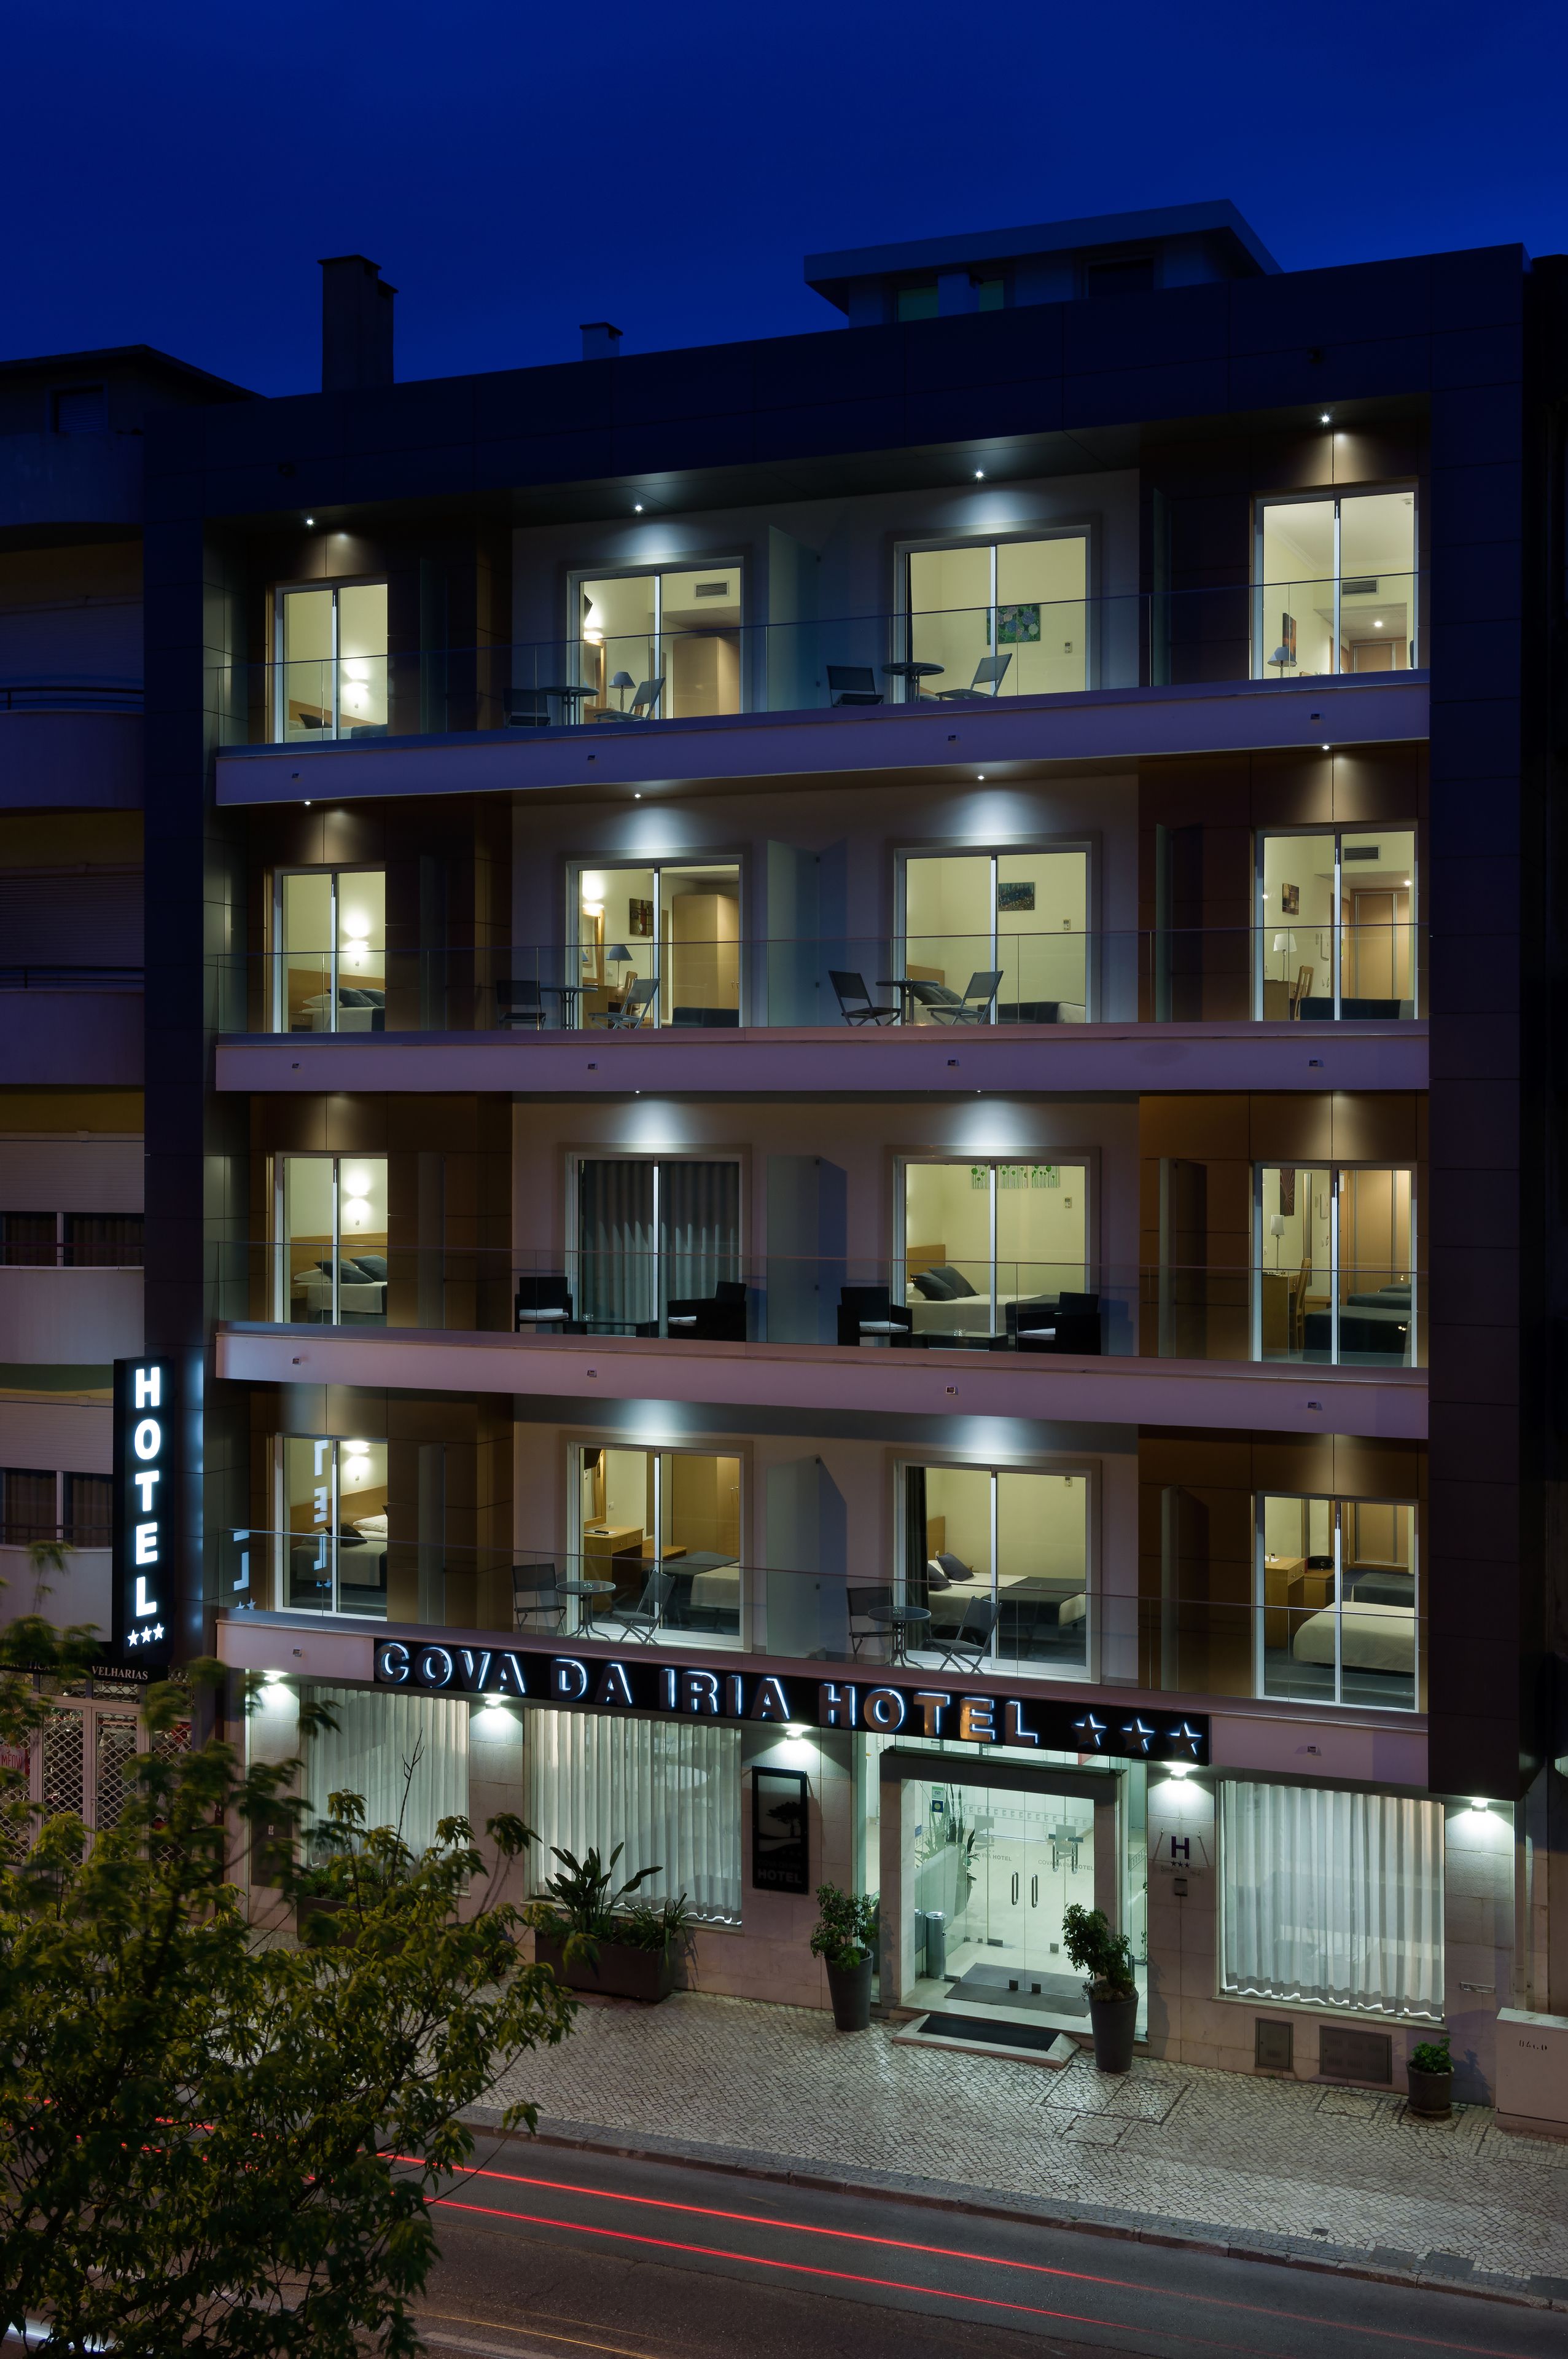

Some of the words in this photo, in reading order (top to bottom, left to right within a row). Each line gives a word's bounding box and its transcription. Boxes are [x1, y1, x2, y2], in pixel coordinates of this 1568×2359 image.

[135, 1366, 161, 1618] HOTEL
[92, 1665, 148, 1680] VELHARIAS
[374, 1643, 526, 1694] COVA
[550, 1658, 633, 1705] DA
[658, 1669, 790, 1720] IRIA
[818, 1683, 1039, 1746] HOTEL
[1171, 1836, 1190, 1860] H
[757, 1868, 803, 1884] HOTEL
